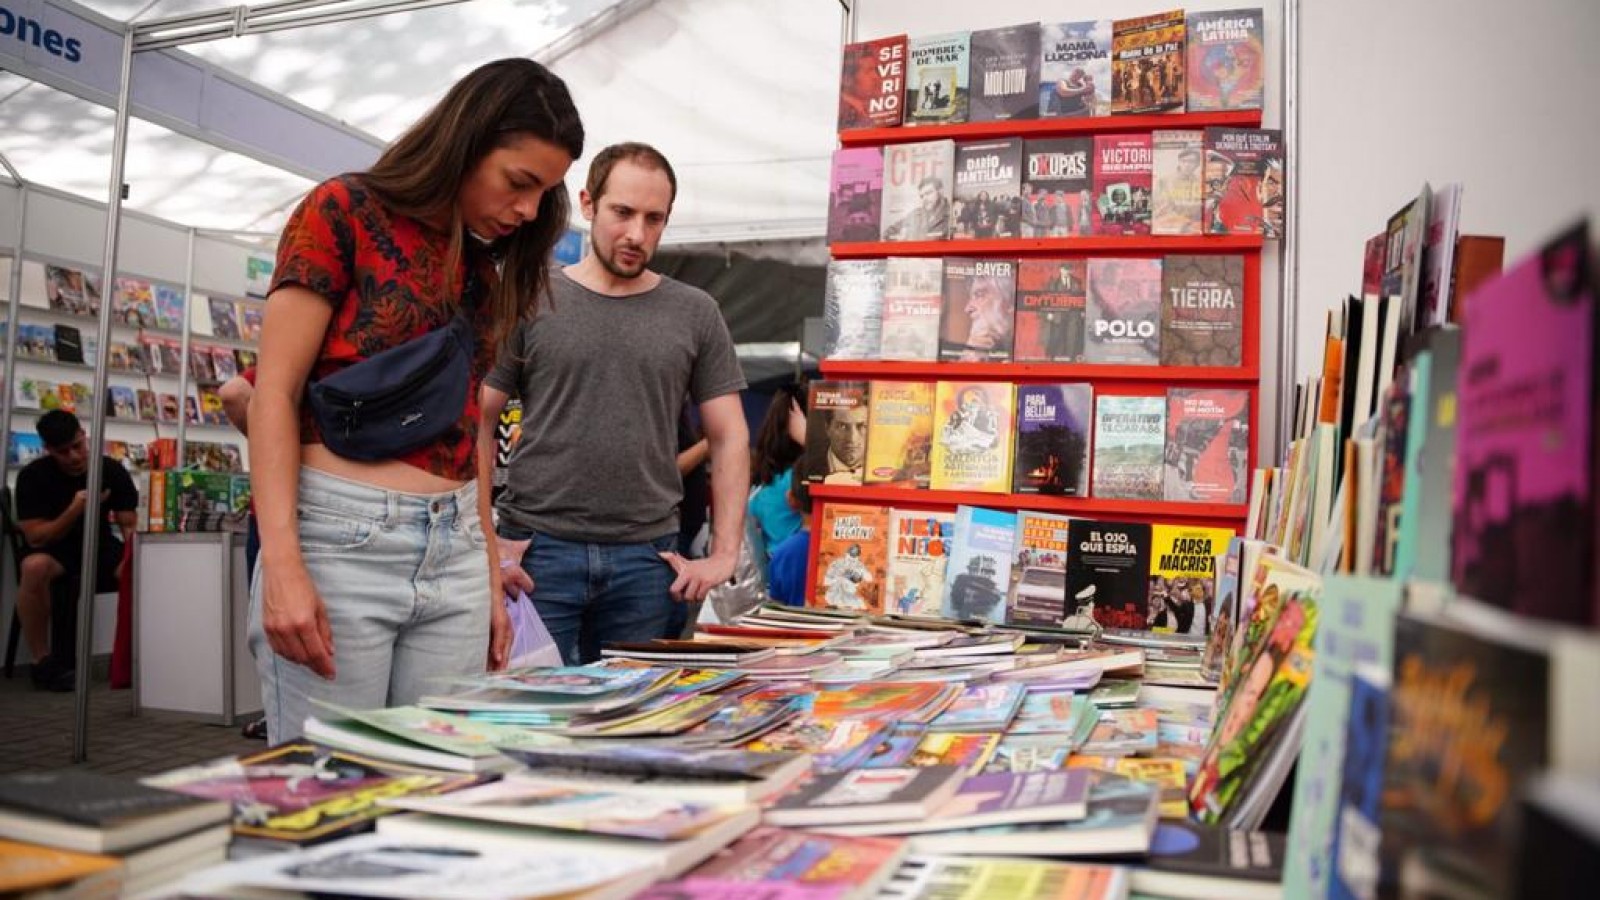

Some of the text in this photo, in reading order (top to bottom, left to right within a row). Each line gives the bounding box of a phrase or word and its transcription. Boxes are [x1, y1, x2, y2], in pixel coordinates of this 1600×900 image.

[1197, 17, 1254, 32] AMÉRICA
[1202, 29, 1248, 42] LATINA
[879, 44, 903, 62] SE
[911, 43, 966, 60] HOMBRES
[1044, 50, 1108, 62] LUCHONA
[878, 60, 903, 76] VE
[881, 77, 899, 95] RI
[869, 95, 898, 112] NO
[966, 154, 999, 171] DARÍO
[975, 262, 1012, 277] BAYER
[1170, 288, 1236, 309] TIERRA
[1094, 319, 1155, 337] POLO
[1090, 532, 1128, 543] EL OJO
[1080, 541, 1137, 555] QUE ESPÍA
[1172, 538, 1212, 555] FARSA
